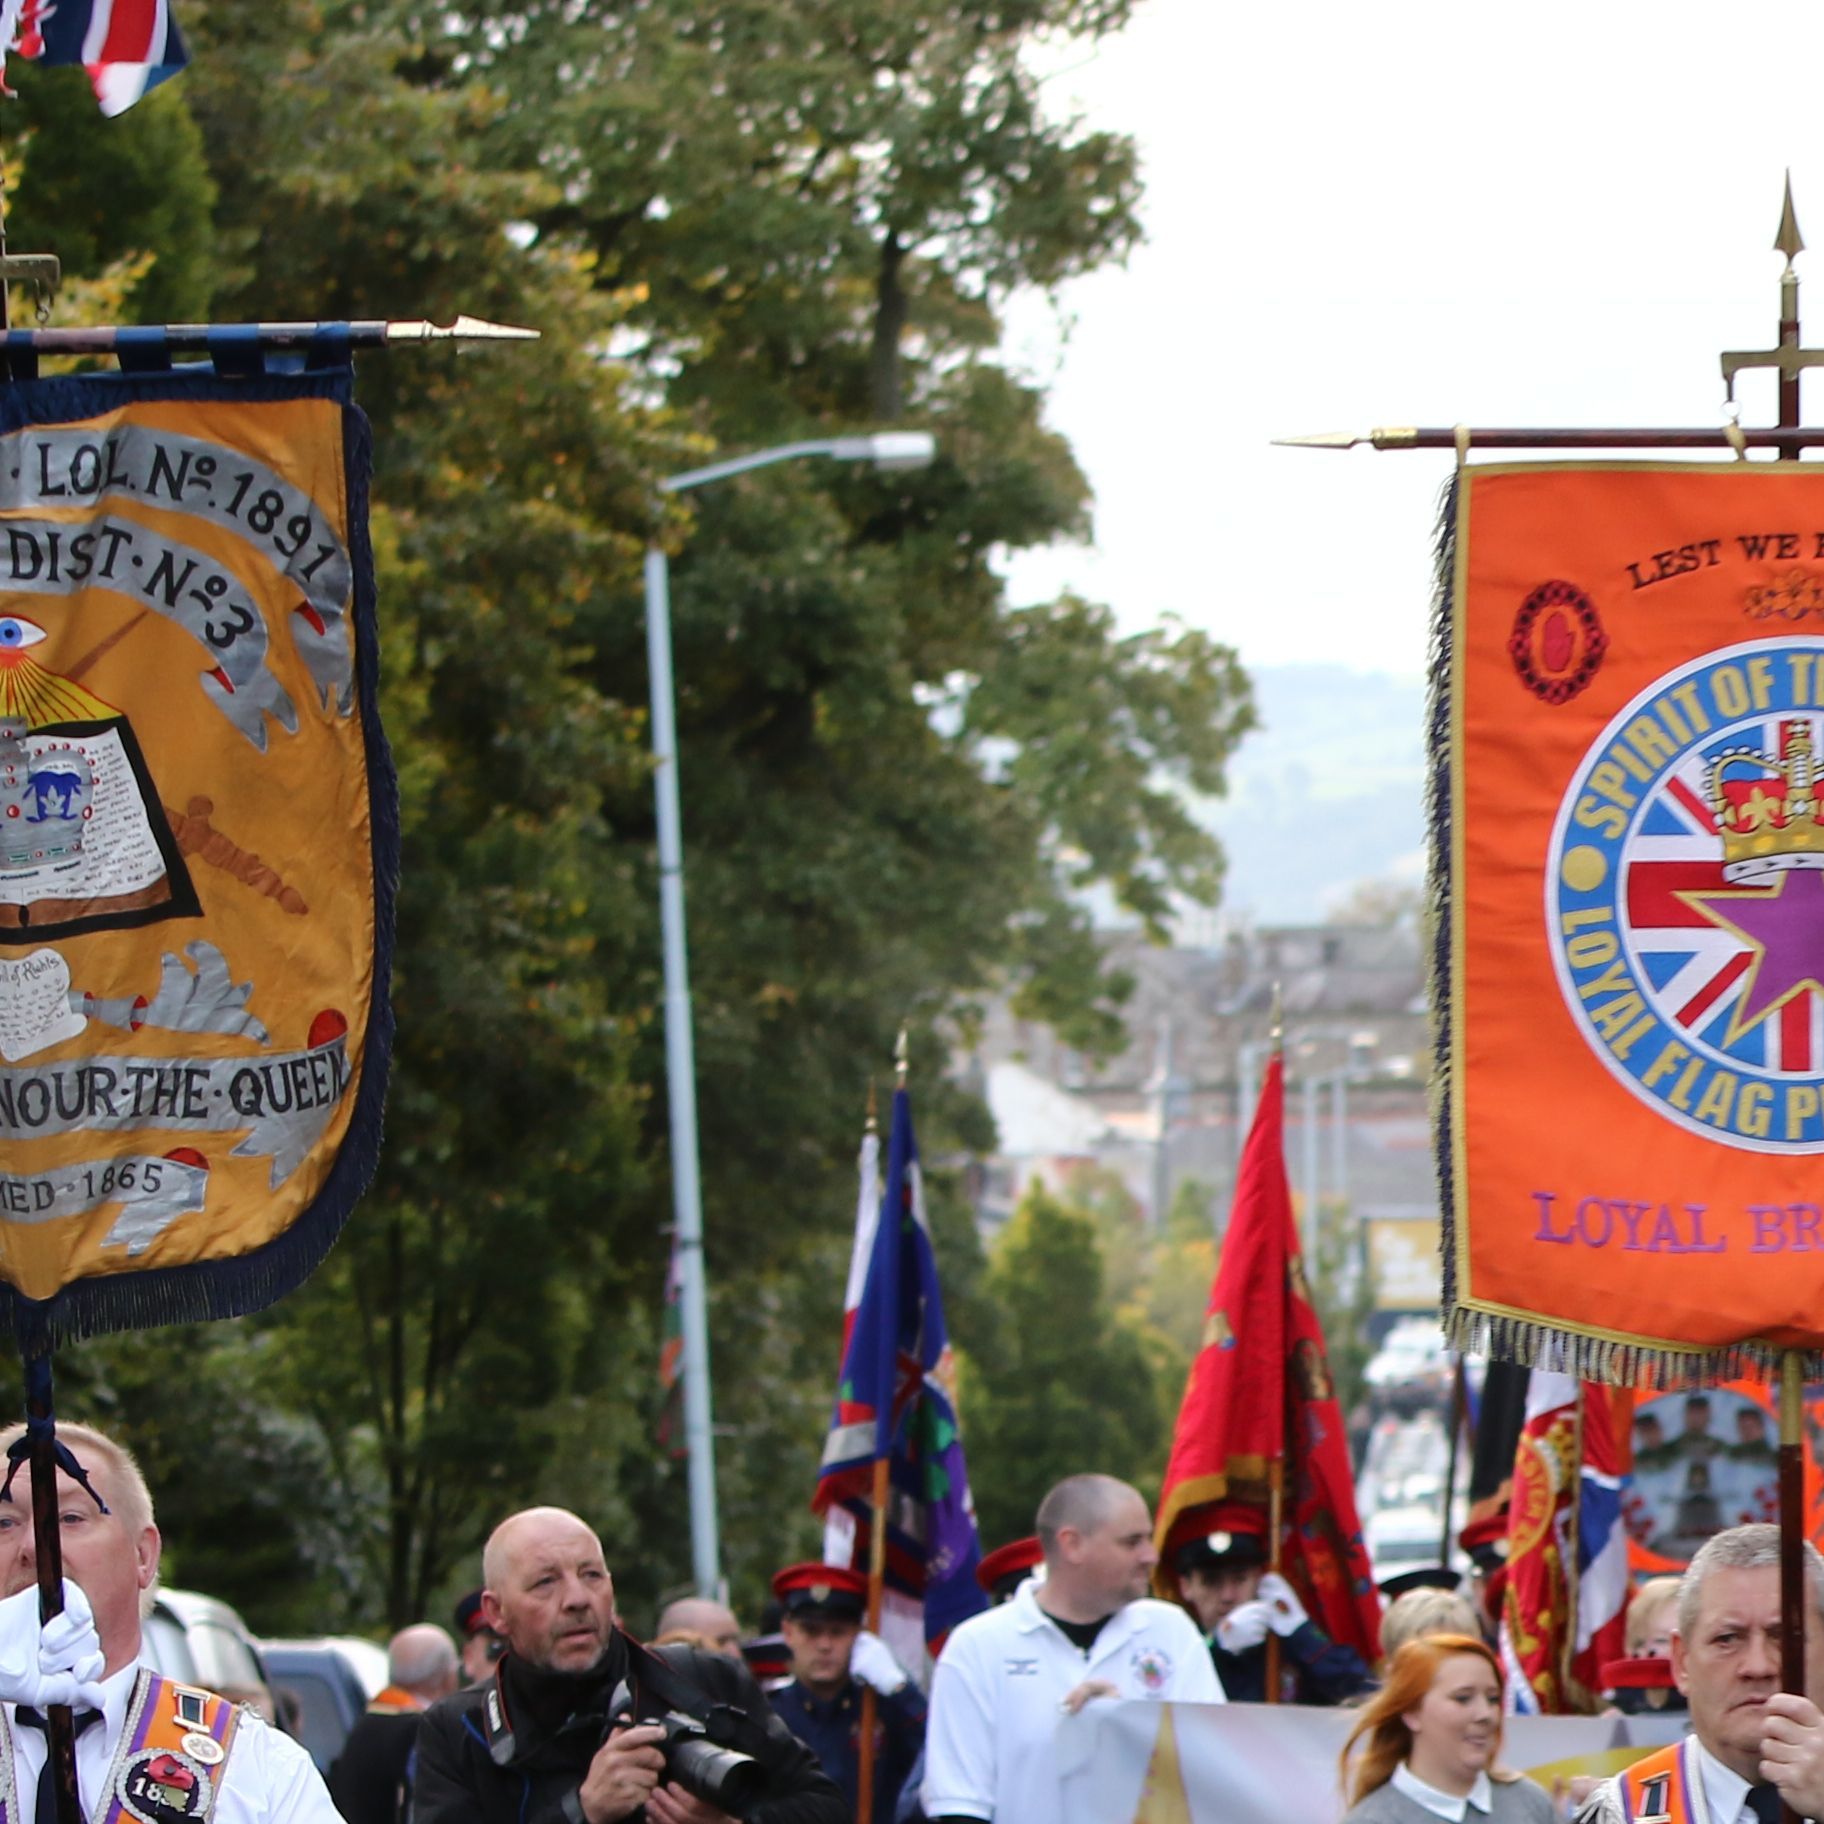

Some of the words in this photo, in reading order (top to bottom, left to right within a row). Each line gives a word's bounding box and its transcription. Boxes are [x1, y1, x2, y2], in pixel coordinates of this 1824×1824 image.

[225, 473, 336, 582] 1891
[1626, 541, 1722, 588] LEST
[1741, 532, 1800, 561] WE
[205, 606, 254, 648] 3
[1574, 675, 1709, 840] SPIRIT
[1715, 654, 1775, 717] OF
[1560, 909, 1657, 1062] LOYAL
[1643, 1048, 1773, 1137] FLAG
[127, 1068, 210, 1118] THE
[229, 1050, 348, 1117] QUEEN
[84, 1163, 163, 1201] 1865
[1531, 1190, 1728, 1255] LOYAL
